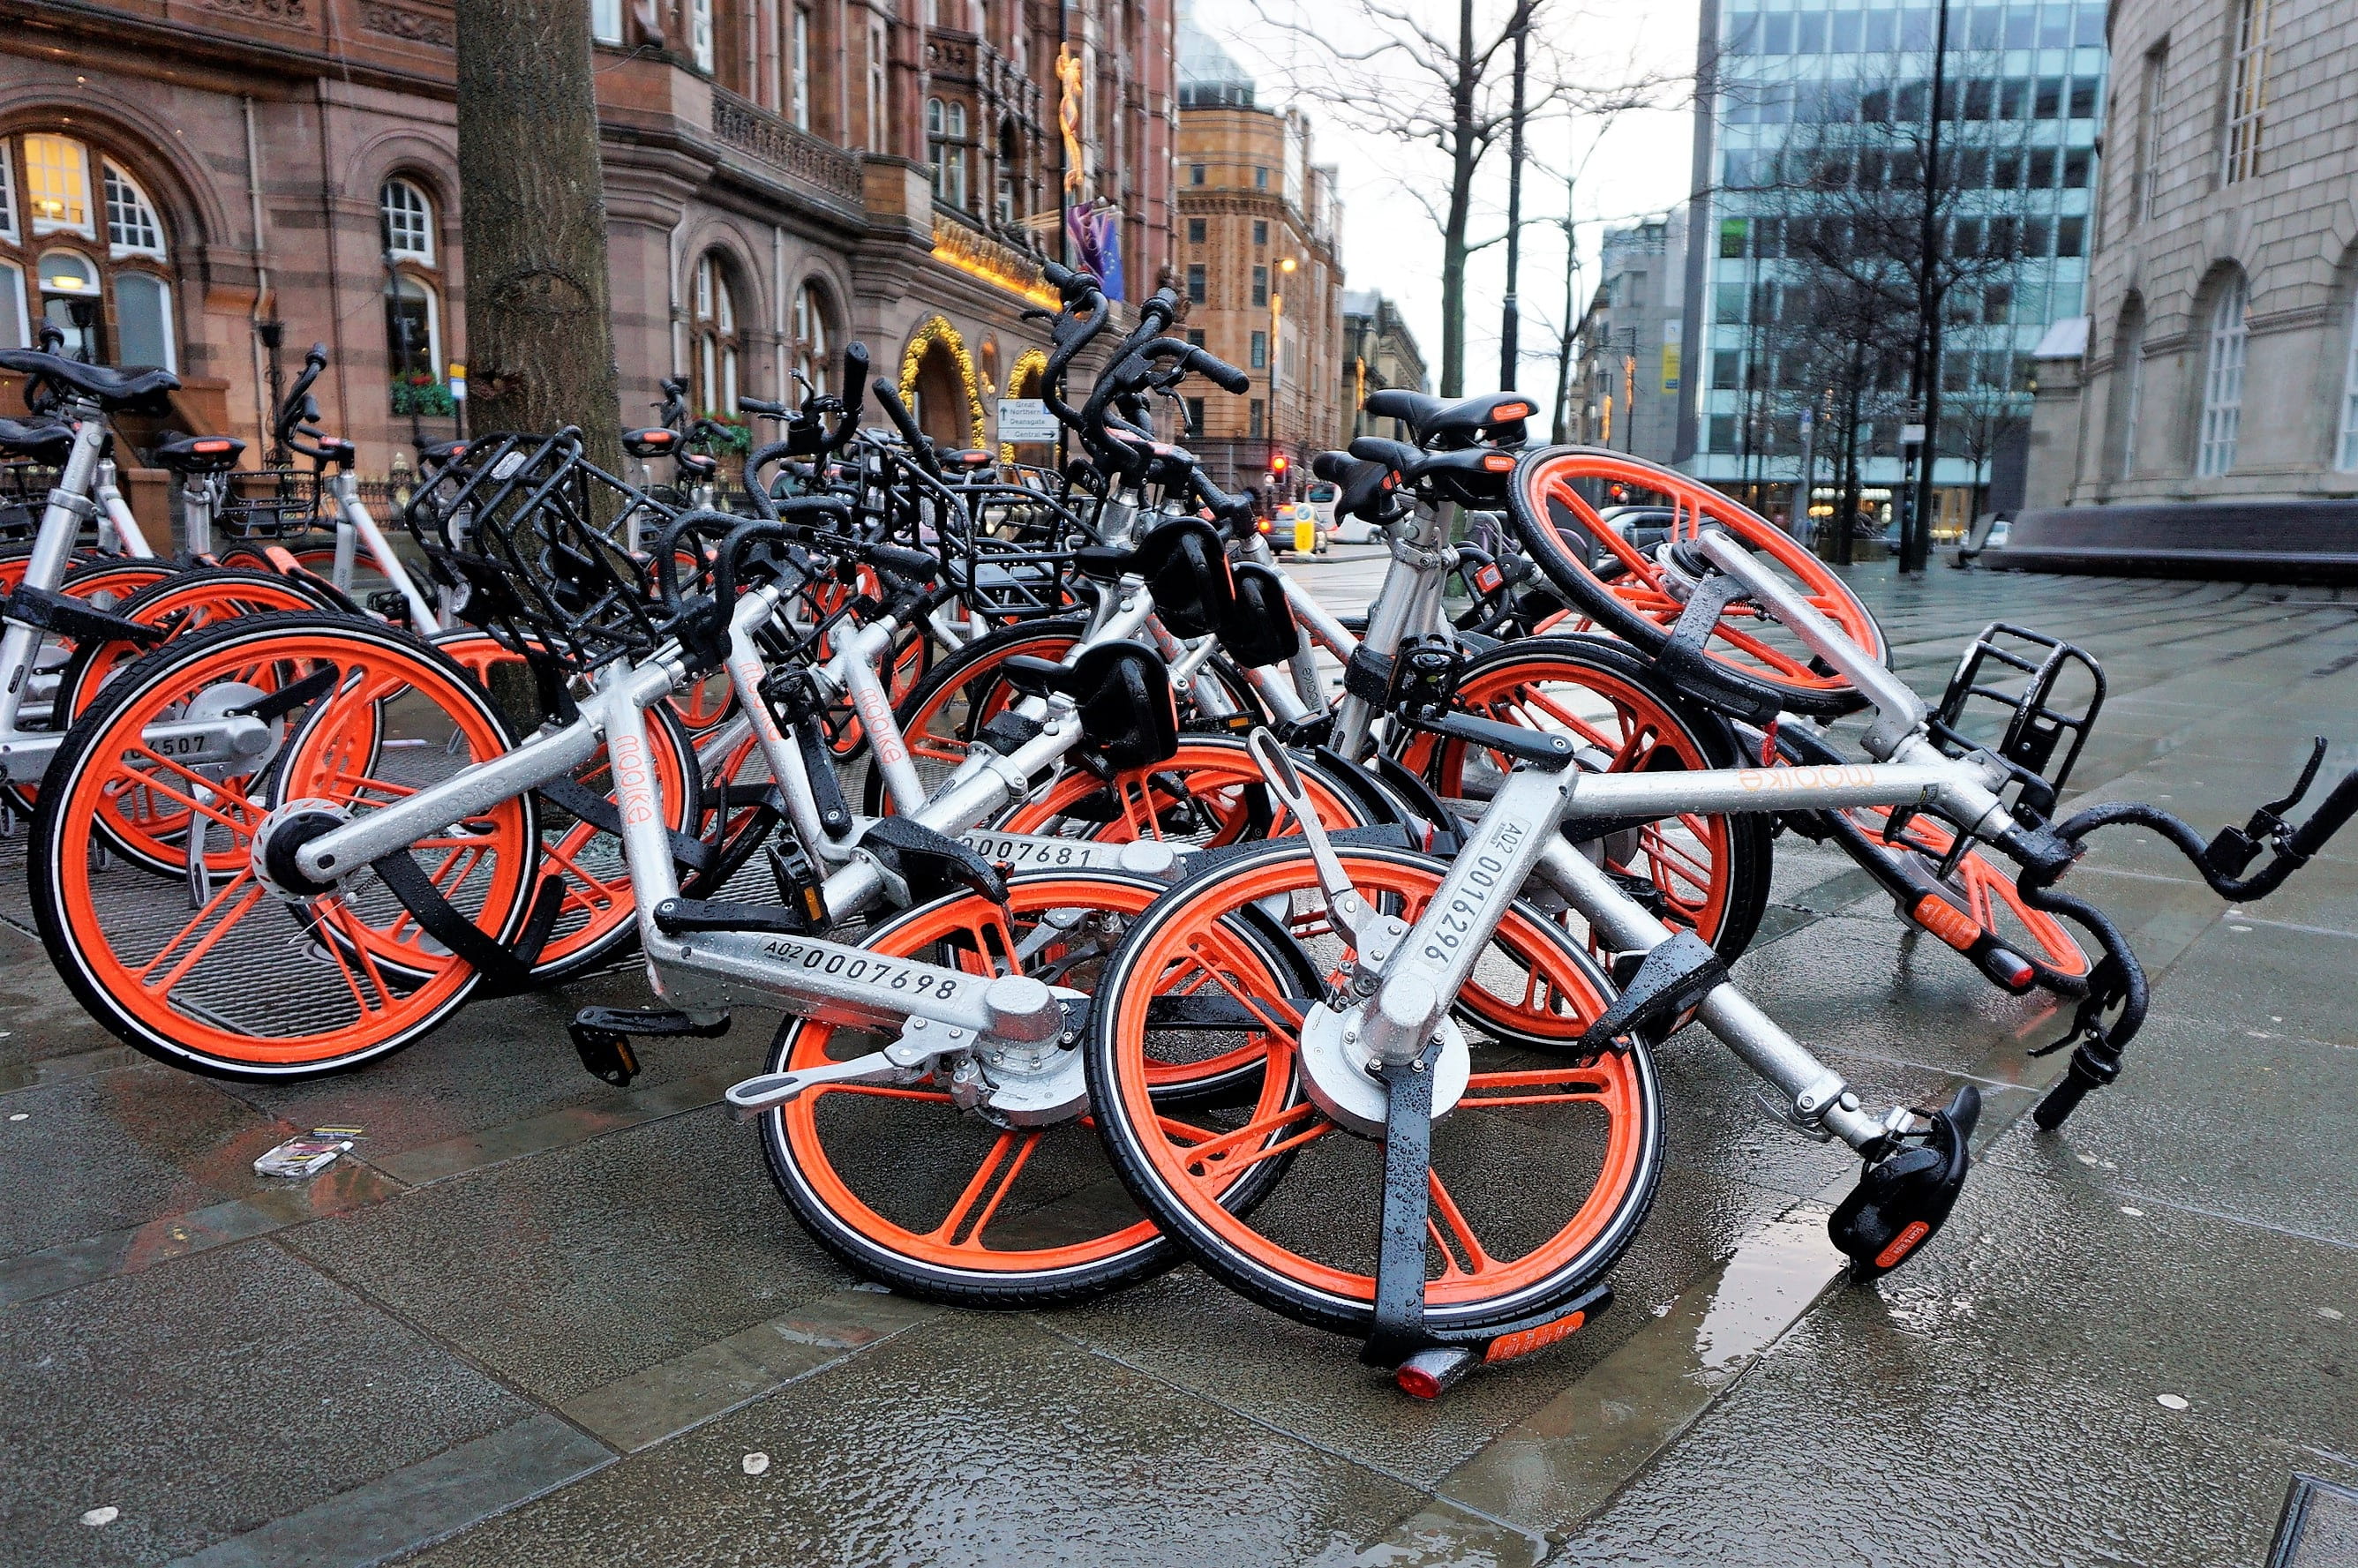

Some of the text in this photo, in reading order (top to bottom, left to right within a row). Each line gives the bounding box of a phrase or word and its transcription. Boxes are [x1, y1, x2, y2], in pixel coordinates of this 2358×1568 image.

[858, 688, 902, 764] mobike
[615, 735, 652, 824] mobike
[1738, 765, 1875, 791] mobike
[1424, 822, 1522, 964] A02 0016296
[764, 942, 957, 1000] A02 0007698
